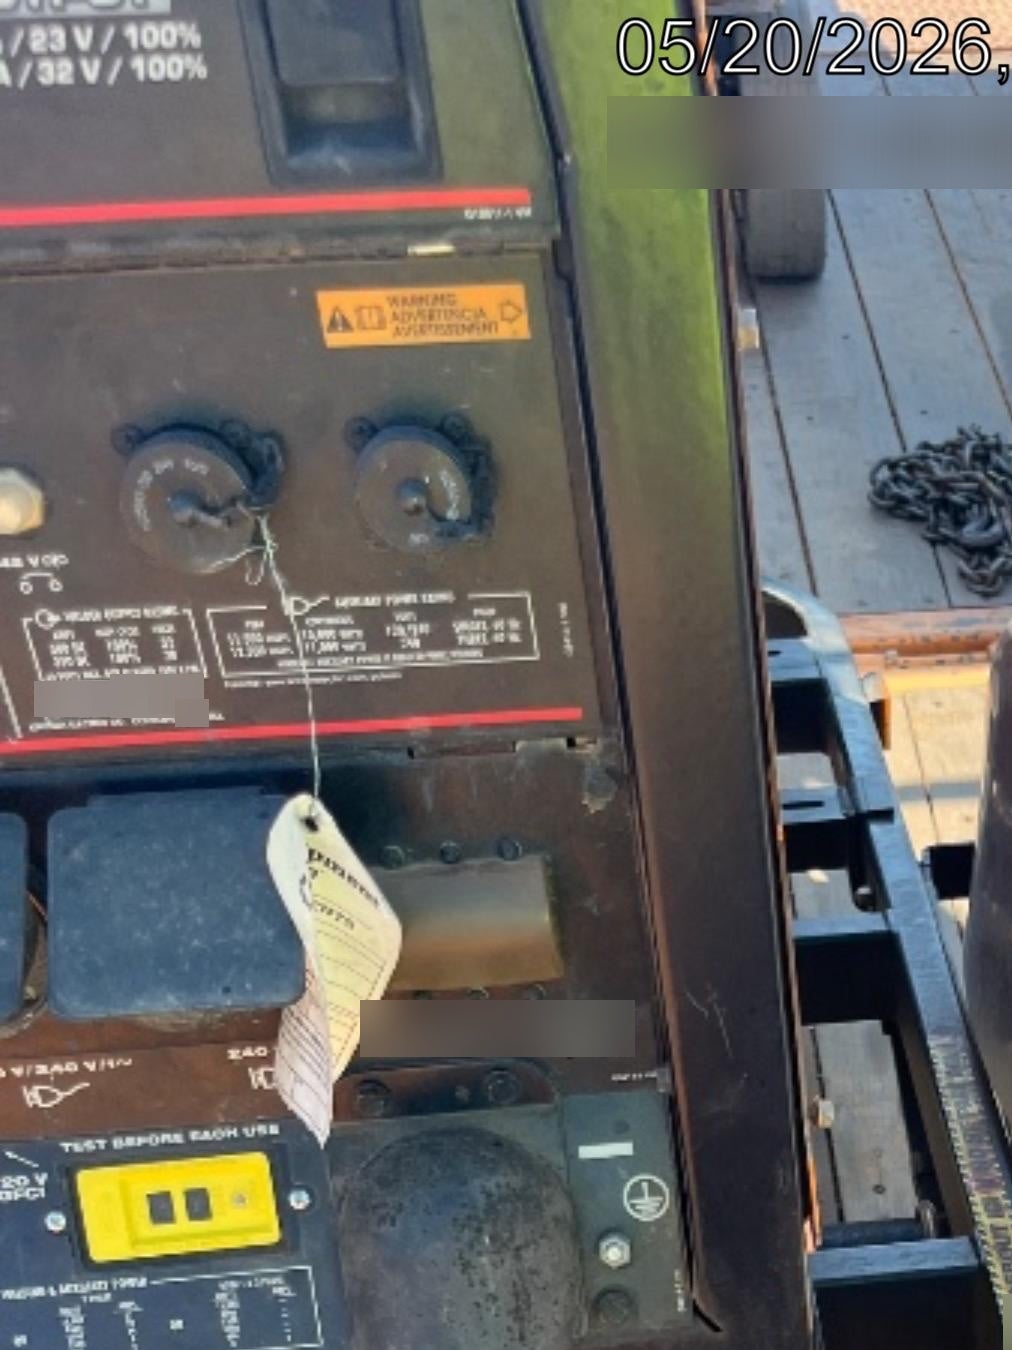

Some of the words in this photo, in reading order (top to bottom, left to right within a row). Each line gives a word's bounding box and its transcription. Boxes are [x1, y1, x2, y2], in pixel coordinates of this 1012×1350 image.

[71, 24, 94, 52] V
[124, 21, 202, 51] 100%
[37, 58, 75, 86] 32
[79, 57, 101, 85] V
[130, 54, 208, 82] 100%
[60, 1140, 107, 1153] TEST
[112, 1133, 184, 1149] BEFORE
[188, 1128, 239, 1142] EACH
[242, 1124, 280, 1137] USE
